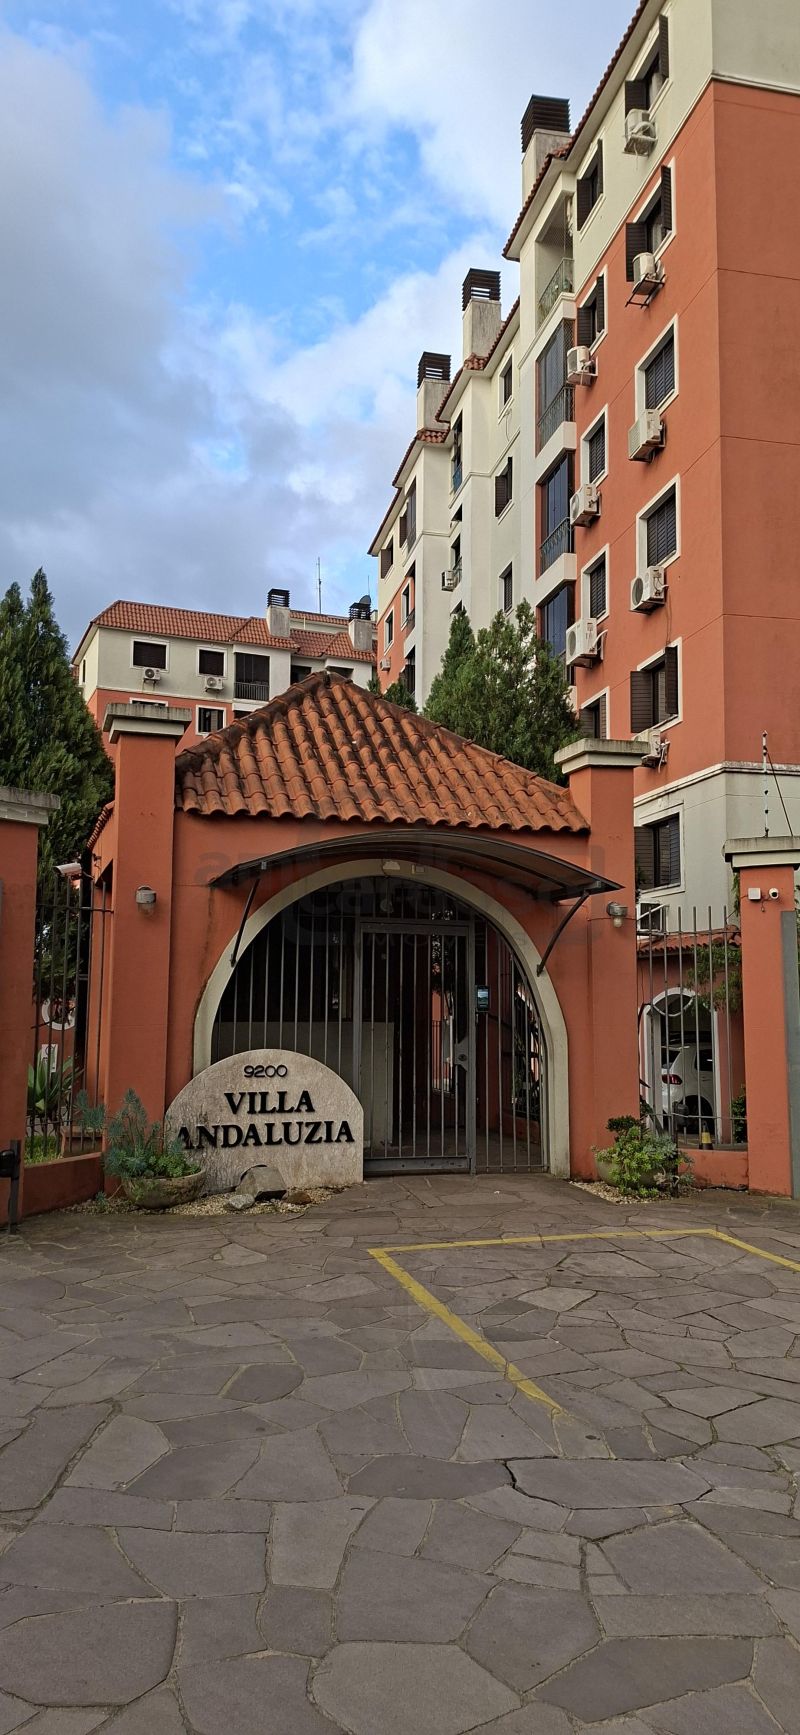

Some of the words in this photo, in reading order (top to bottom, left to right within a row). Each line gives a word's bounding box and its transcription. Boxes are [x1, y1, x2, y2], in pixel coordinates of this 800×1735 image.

[244, 1065, 288, 1077] 9200
[224, 1090, 315, 1114] VILLA
[177, 1121, 355, 1150] ANDALUZIA
